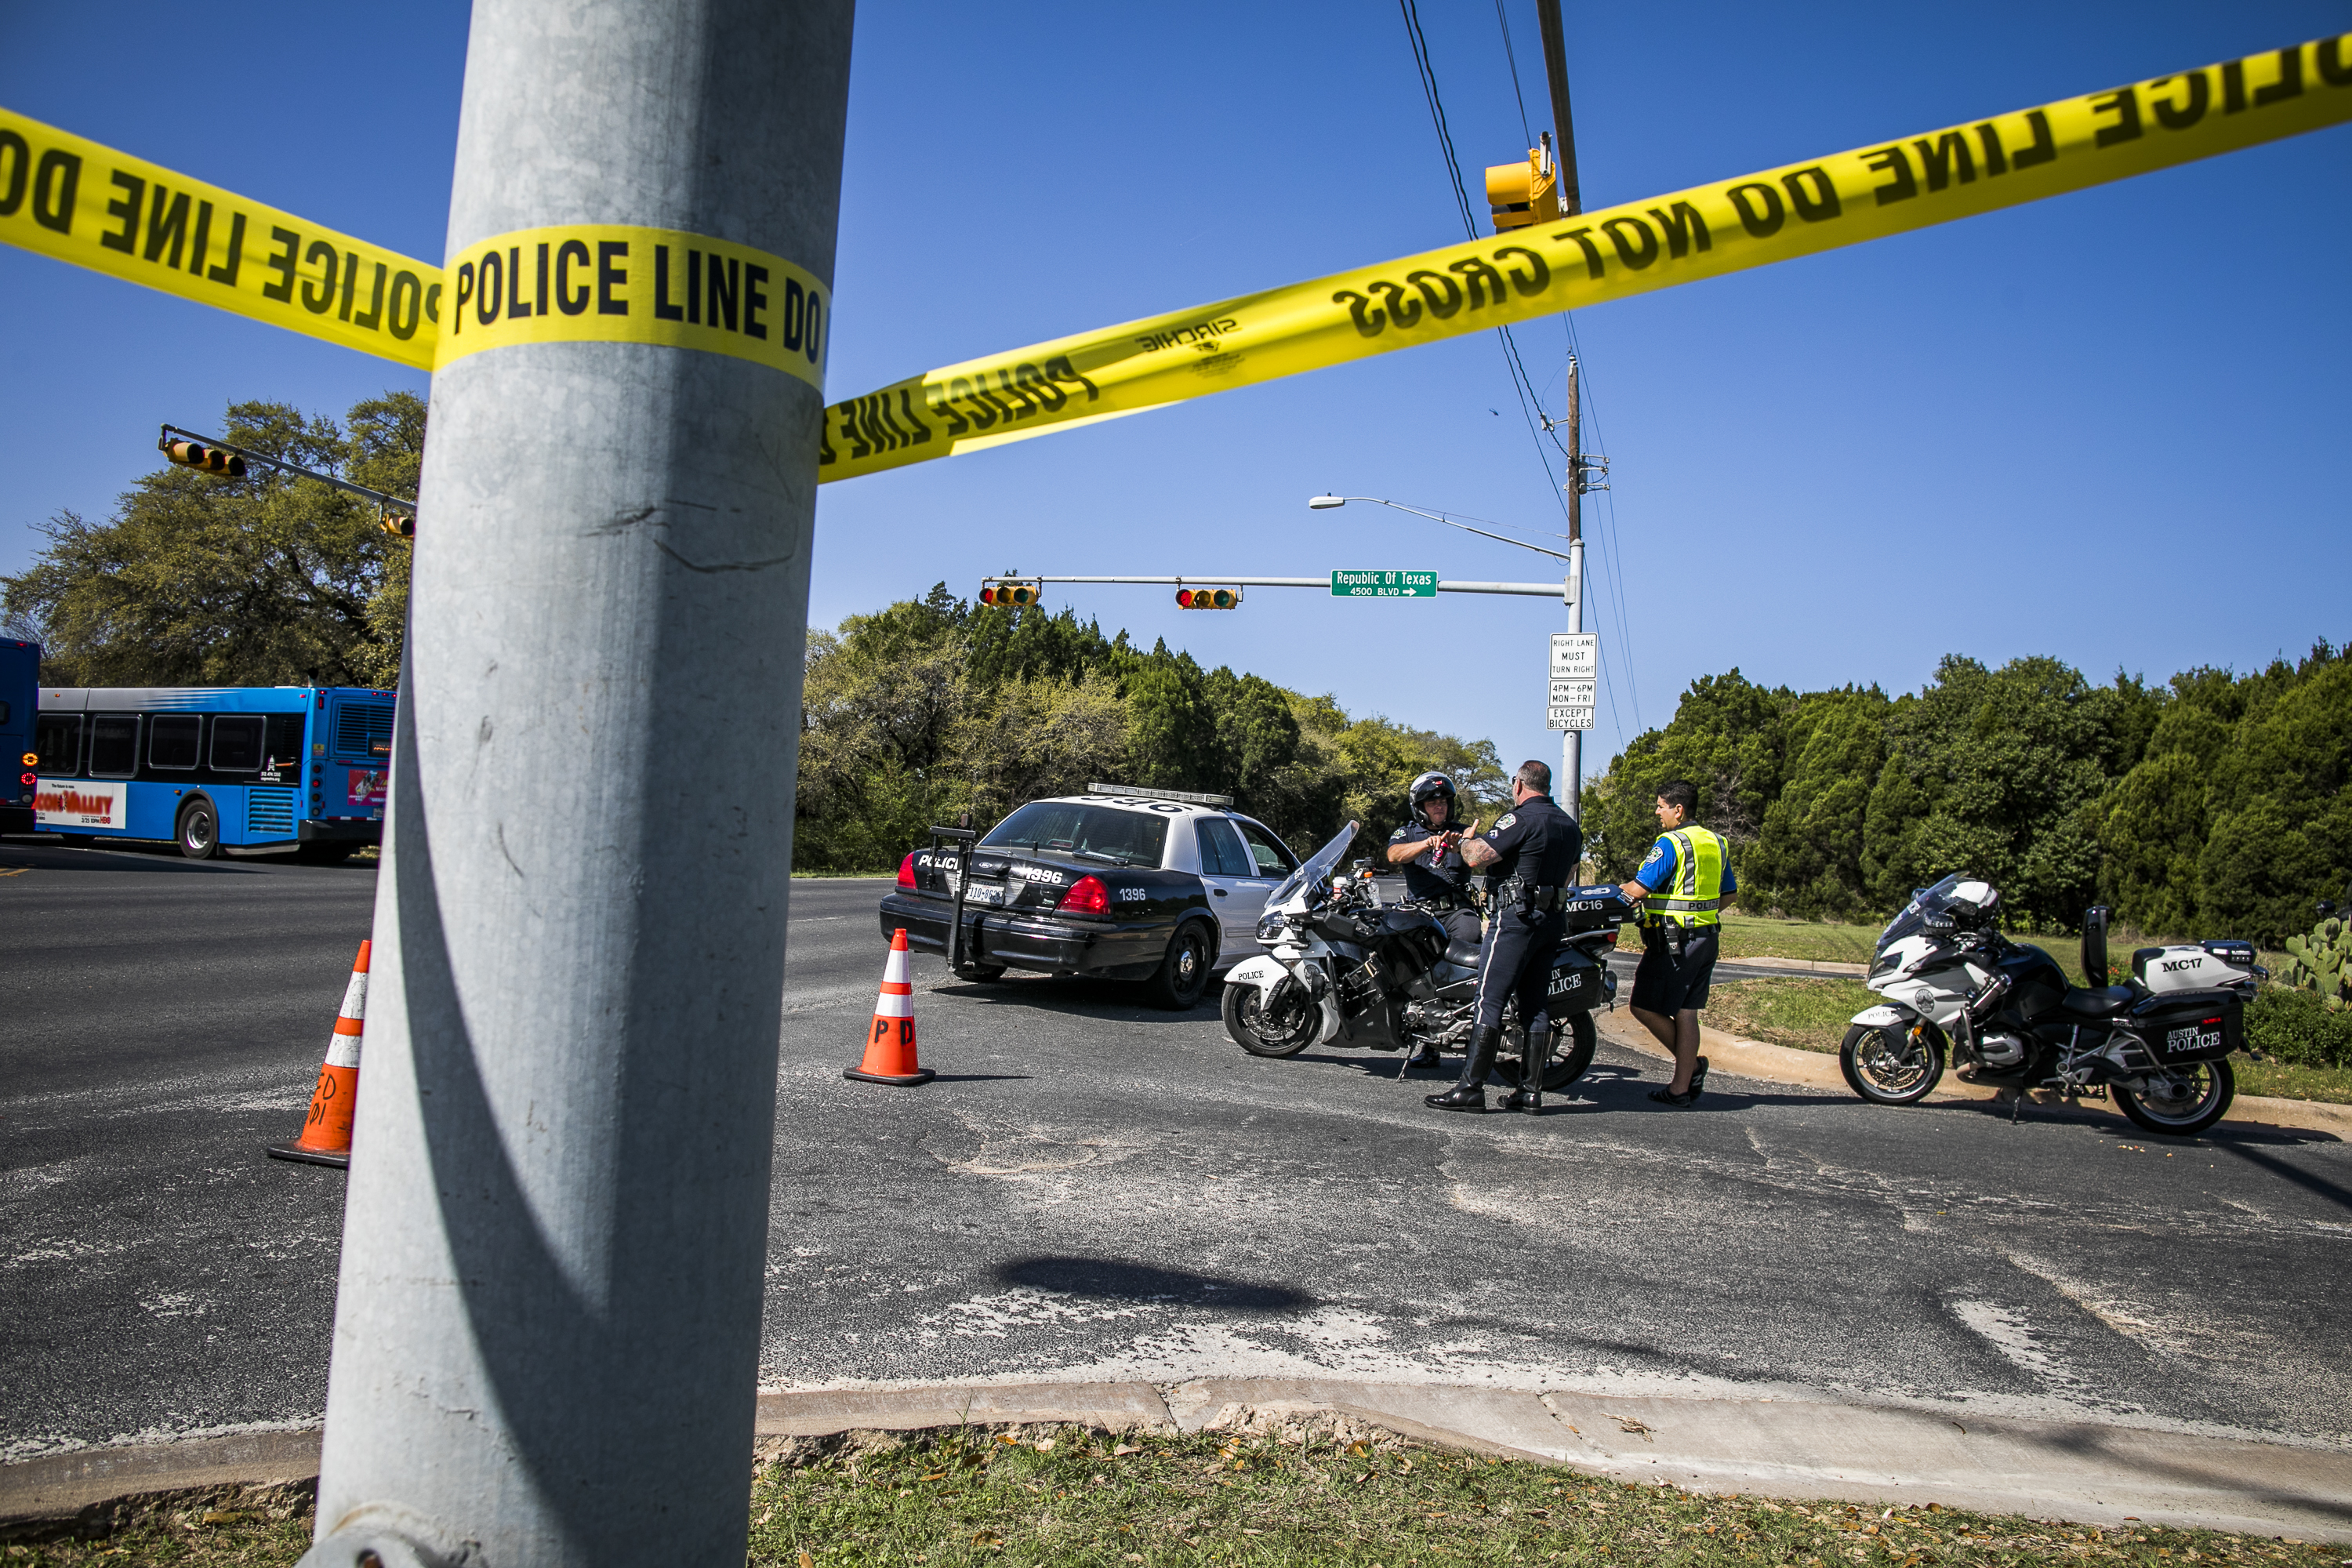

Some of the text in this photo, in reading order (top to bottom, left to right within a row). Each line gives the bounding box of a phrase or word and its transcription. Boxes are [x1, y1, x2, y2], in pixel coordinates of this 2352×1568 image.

[454, 240, 821, 364] POLICE LINE DO
[1337, 572, 1431, 586] Republic Of Texas
[1350, 587, 1399, 596] 4500 BLVD
[1562, 652, 1584, 660] MUST
[1554, 709, 1586, 717] EXCEPT
[1549, 719, 1592, 728] BICYCLES
[918, 855, 959, 870] POLIC
[1119, 887, 1145, 901] 1396
[1566, 900, 1603, 912] MC16
[1689, 899, 1719, 909] POLICE
[2161, 957, 2202, 973] MC17
[1238, 970, 1264, 980] POLICE
[1867, 1010, 1896, 1018] POLICE
[2167, 1026, 2198, 1040] AUSTIN
[2167, 1032, 2221, 1053] POLICE
